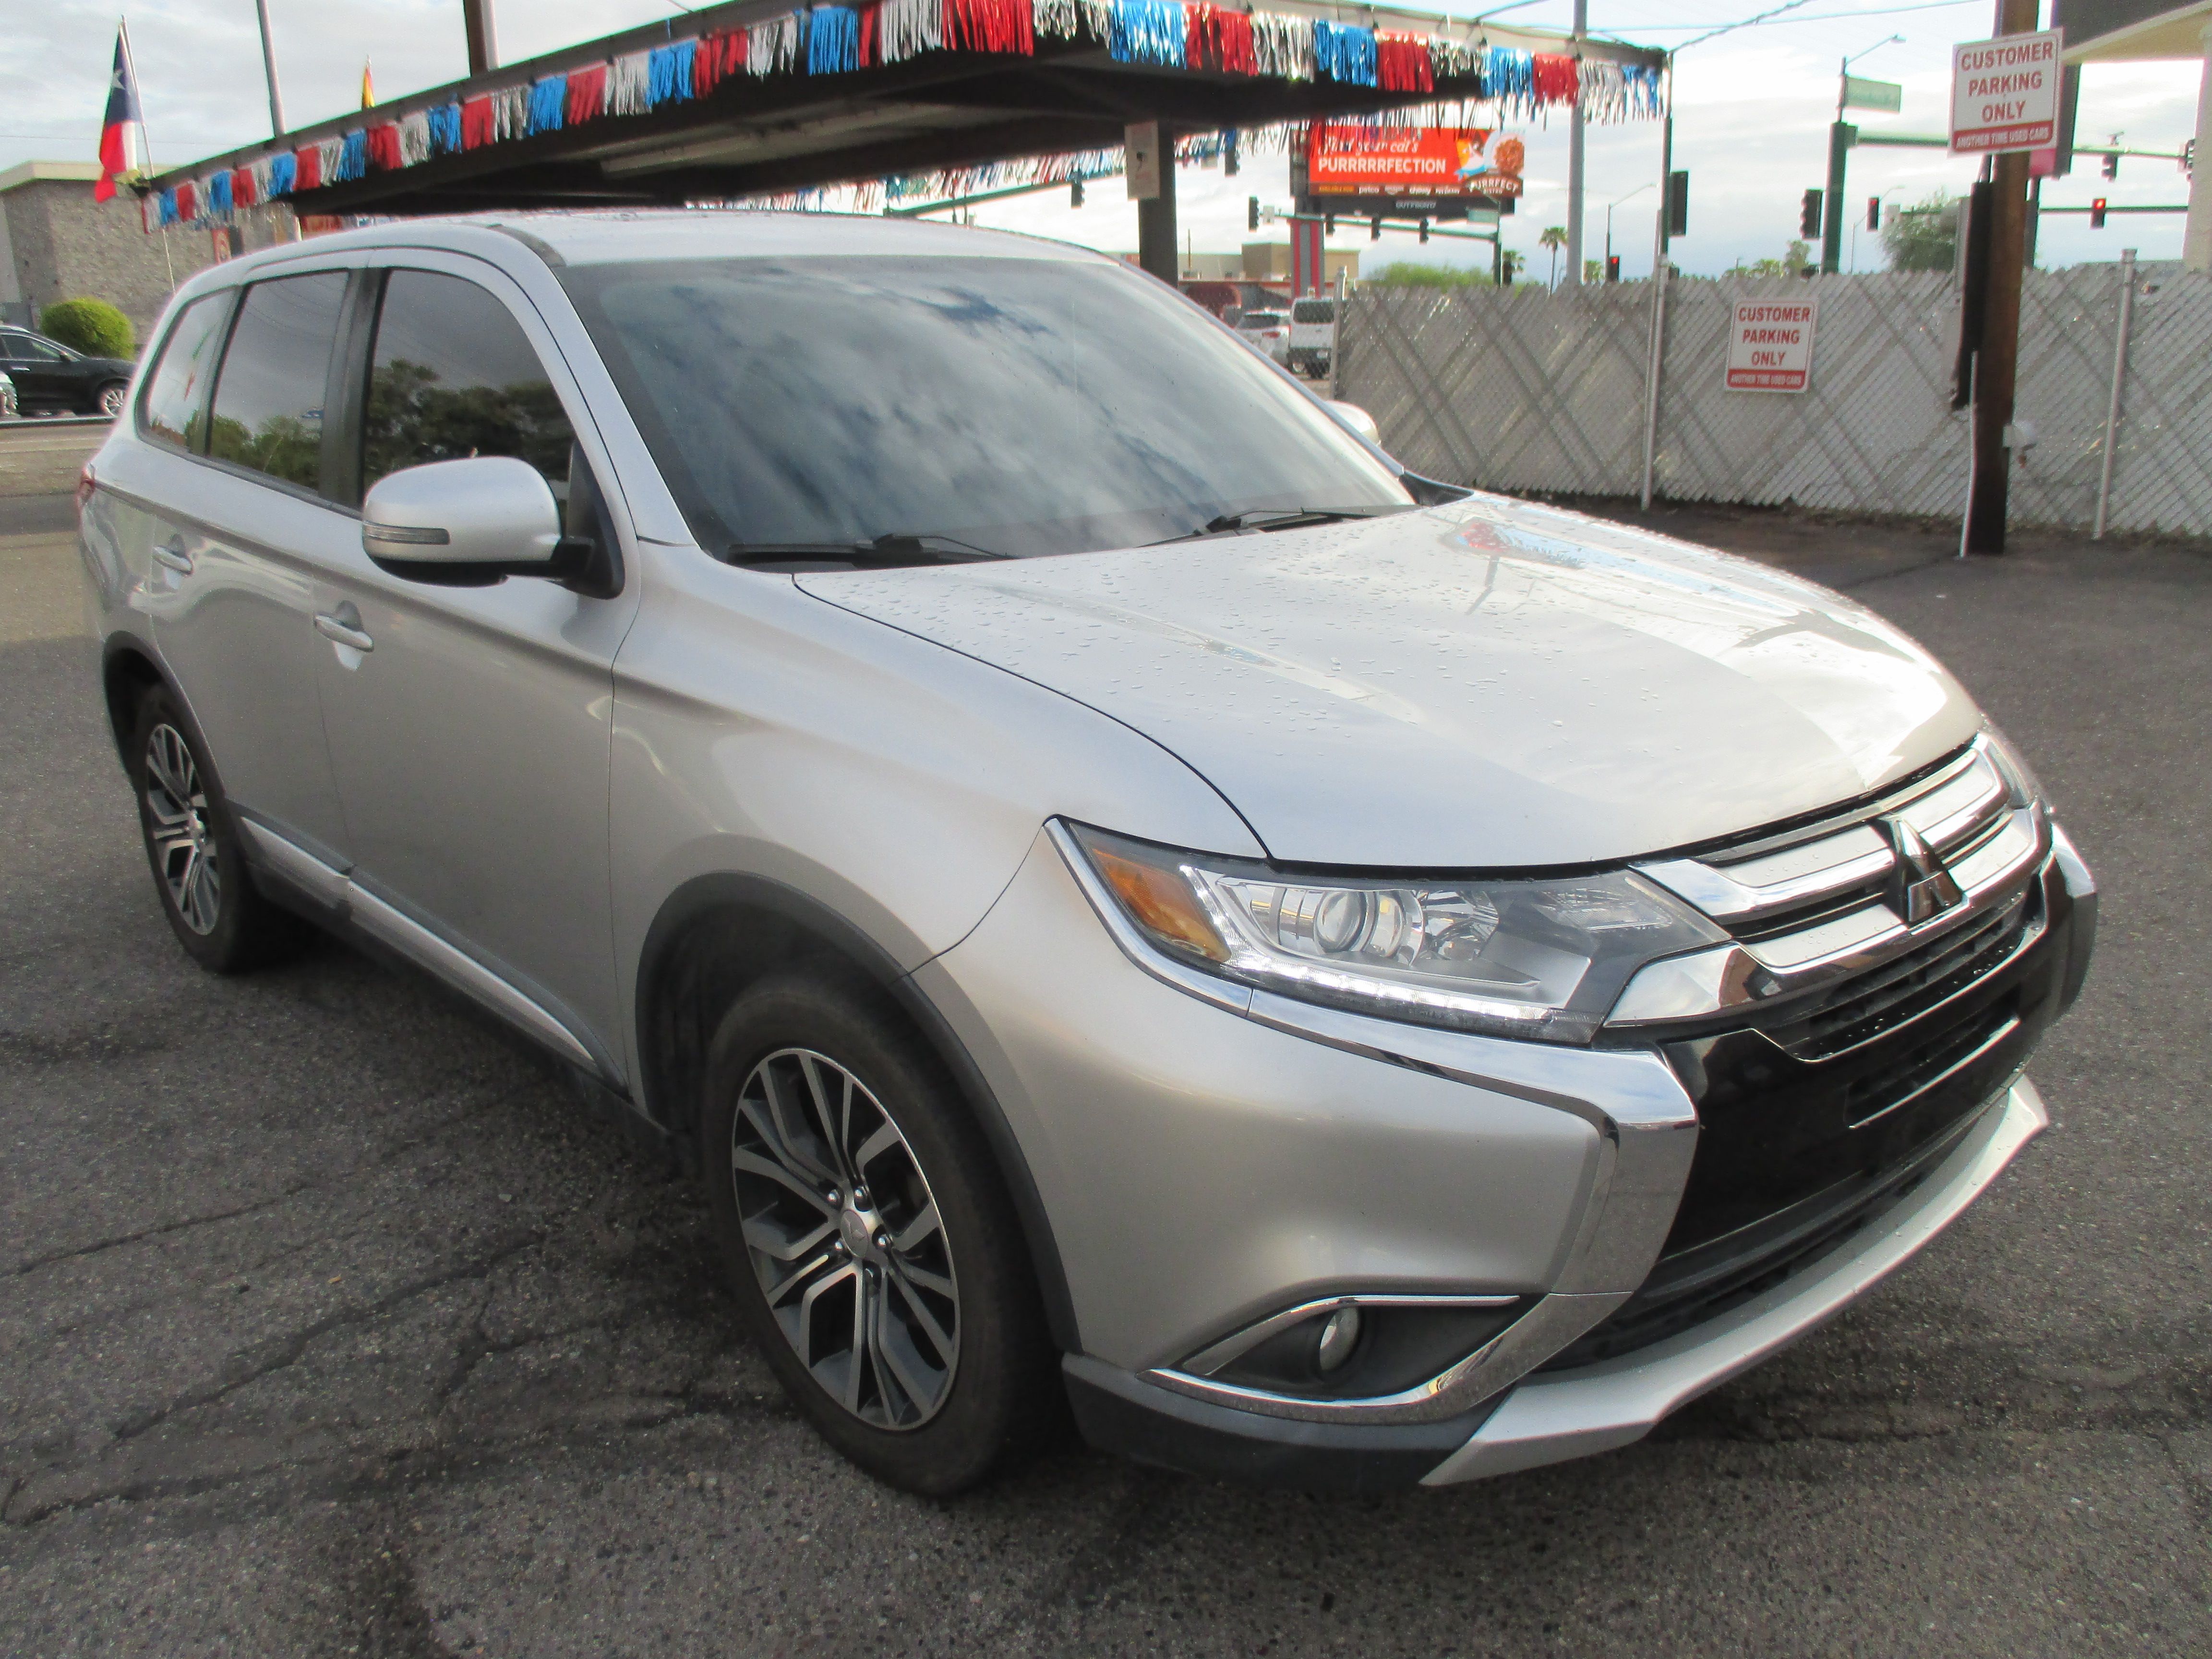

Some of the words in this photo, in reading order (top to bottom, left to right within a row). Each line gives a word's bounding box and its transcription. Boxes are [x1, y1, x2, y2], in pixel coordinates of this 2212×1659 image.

[1961, 41, 2053, 71] CUSTOMER
[1968, 71, 2042, 97] PARKING
[1982, 99, 2026, 123] ONLY
[1390, 136, 1419, 153] cat's
[1956, 134, 1989, 149] ANOTHER
[2009, 129, 2028, 143] USED
[2030, 127, 2049, 141] CARS
[1318, 157, 1446, 174] PURRRRRFECTION
[1739, 307, 1810, 322] CUSTOMER
[1742, 329, 1800, 344] PARKING
[1751, 351, 1786, 366] ONLY
